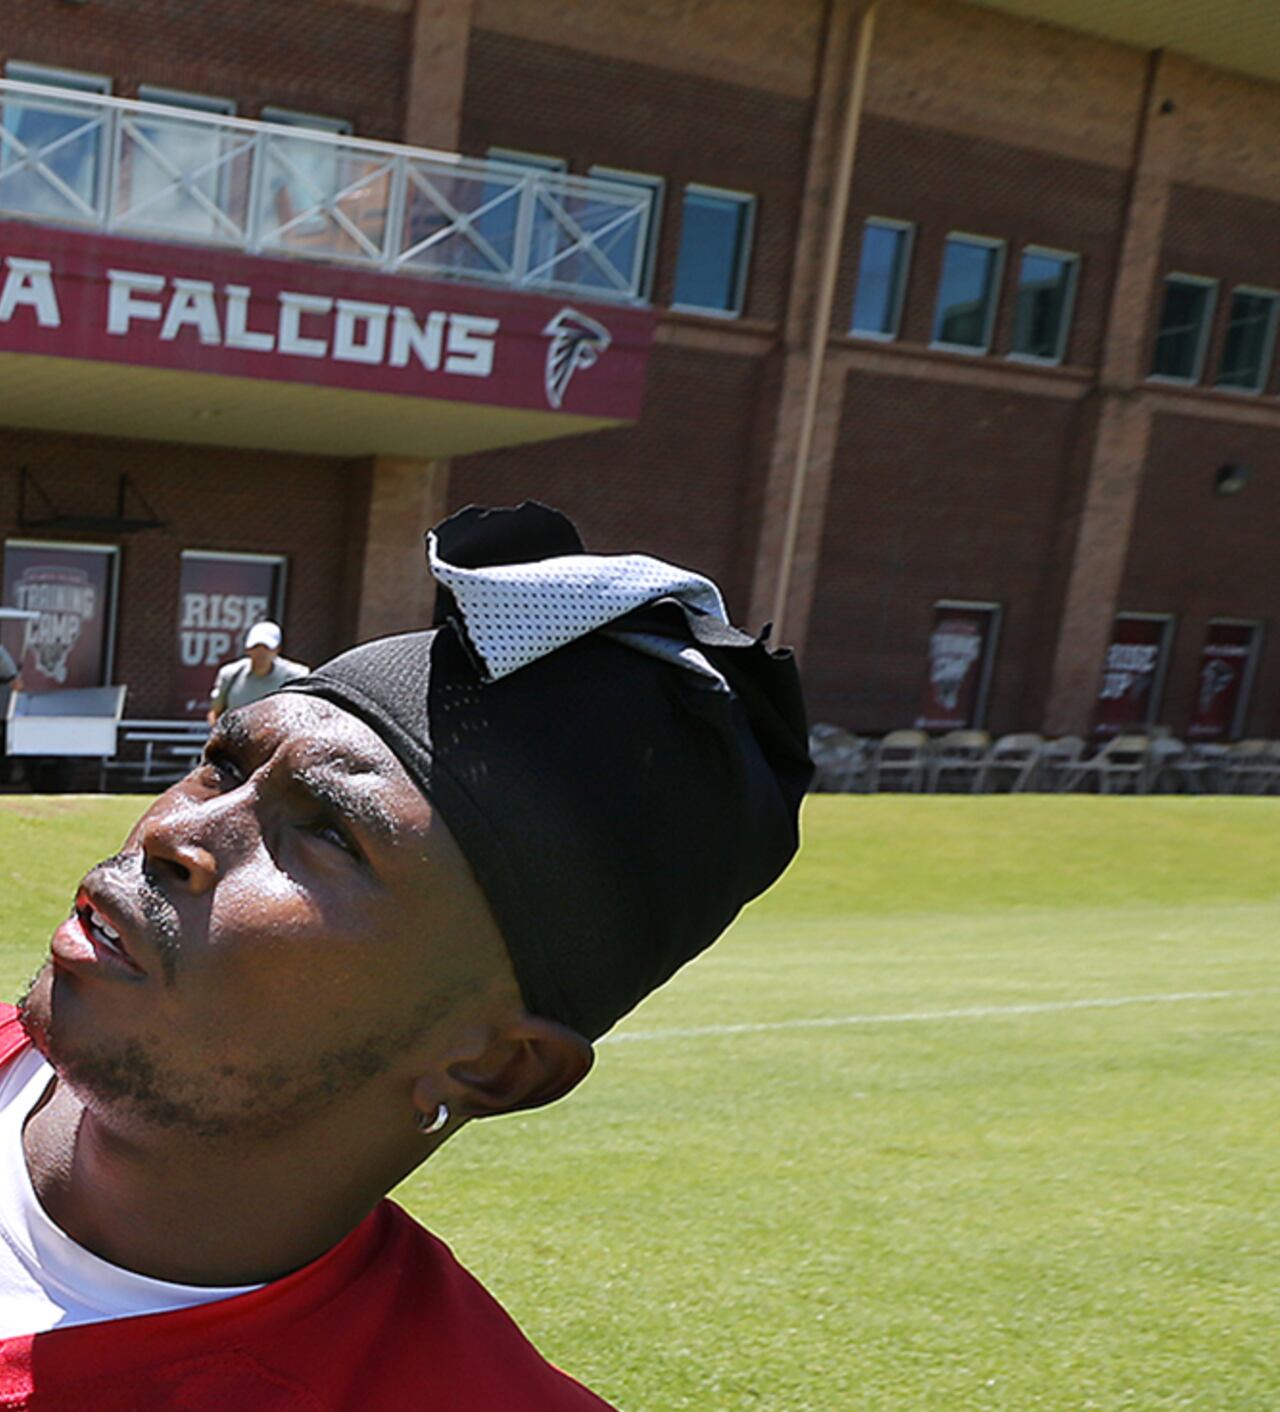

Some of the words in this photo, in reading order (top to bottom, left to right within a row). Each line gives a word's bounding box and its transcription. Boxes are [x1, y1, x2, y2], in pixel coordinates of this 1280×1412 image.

[106, 268, 500, 378] FALCONS
[181, 593, 268, 629] RISE
[180, 631, 231, 667] UP
